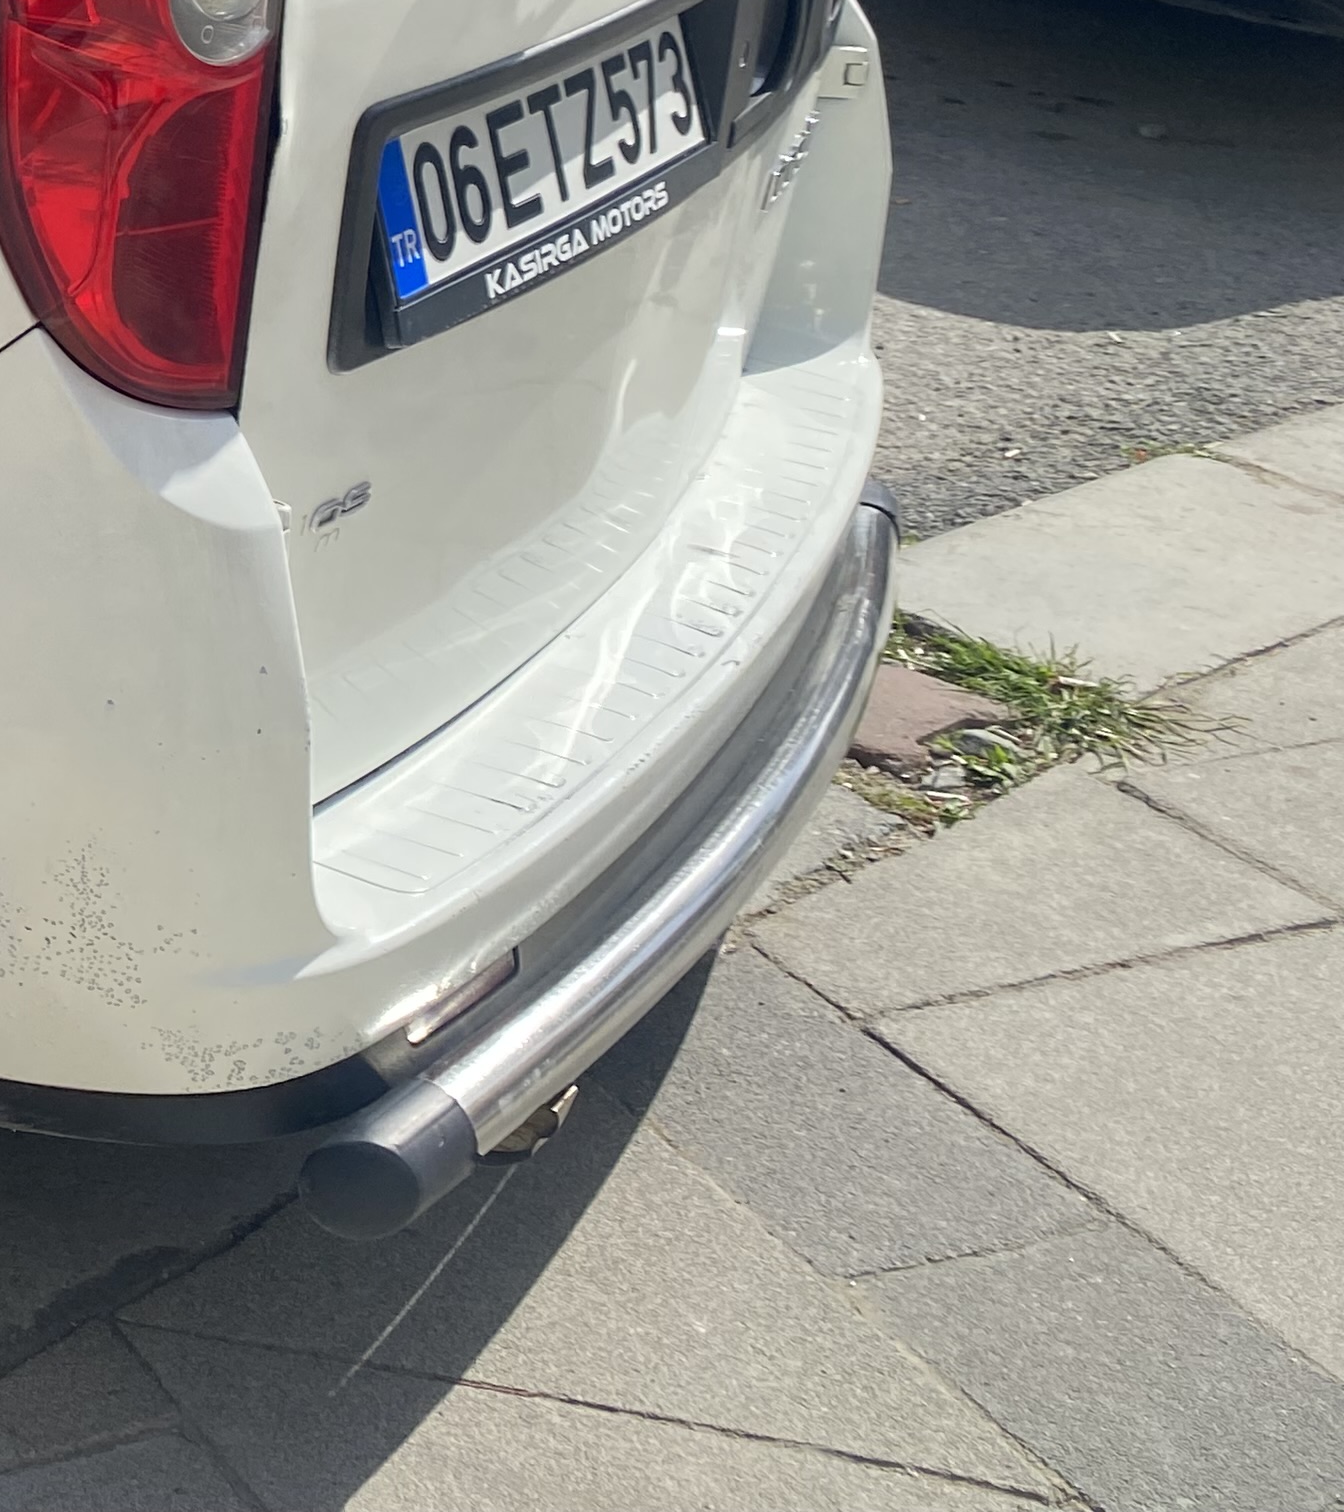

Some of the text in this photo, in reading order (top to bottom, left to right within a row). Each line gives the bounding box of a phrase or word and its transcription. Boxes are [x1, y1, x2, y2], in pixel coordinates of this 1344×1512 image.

[413, 31, 694, 261] 06ETZ573
[392, 229, 421, 268] TR
[485, 181, 670, 299] KASIRGA MOTORS
